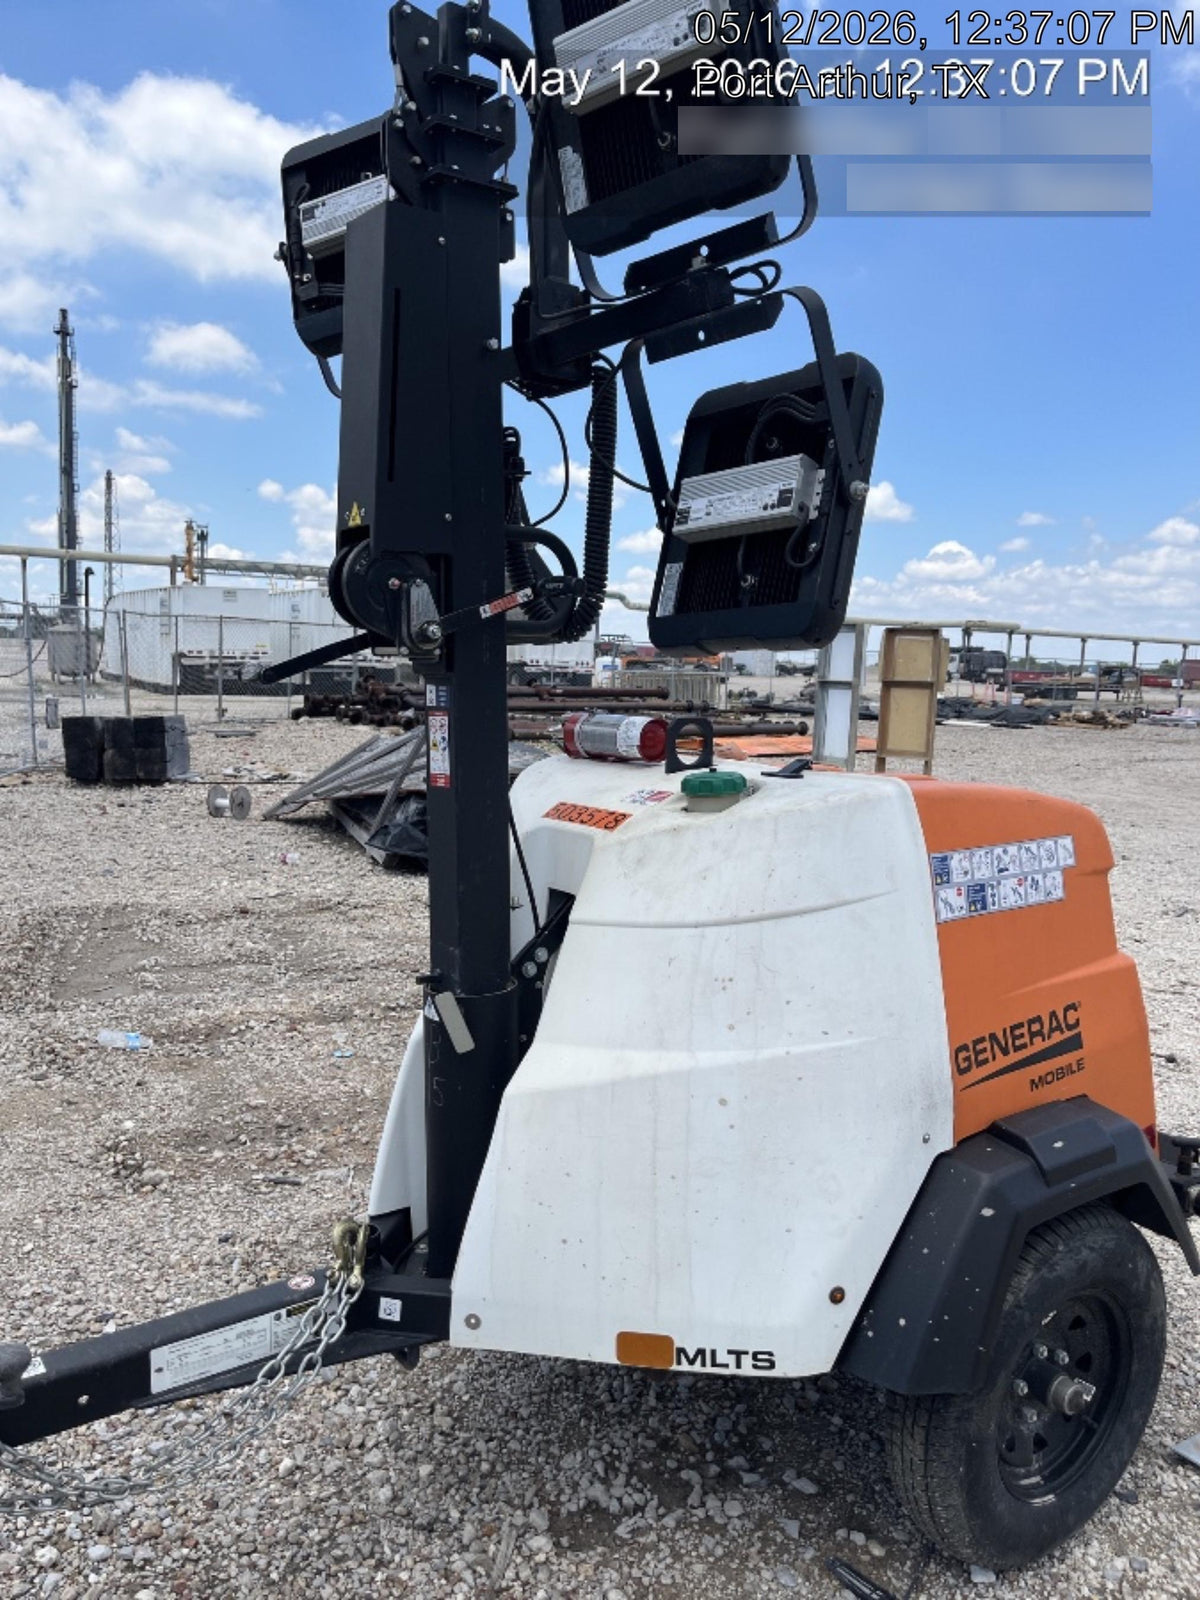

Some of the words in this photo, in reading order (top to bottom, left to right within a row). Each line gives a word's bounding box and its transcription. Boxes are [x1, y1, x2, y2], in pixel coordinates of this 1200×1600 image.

[954, 1001, 1080, 1076] GENERAC
[1030, 1056, 1086, 1092] MOBILE
[676, 1346, 776, 1370] MLTS
